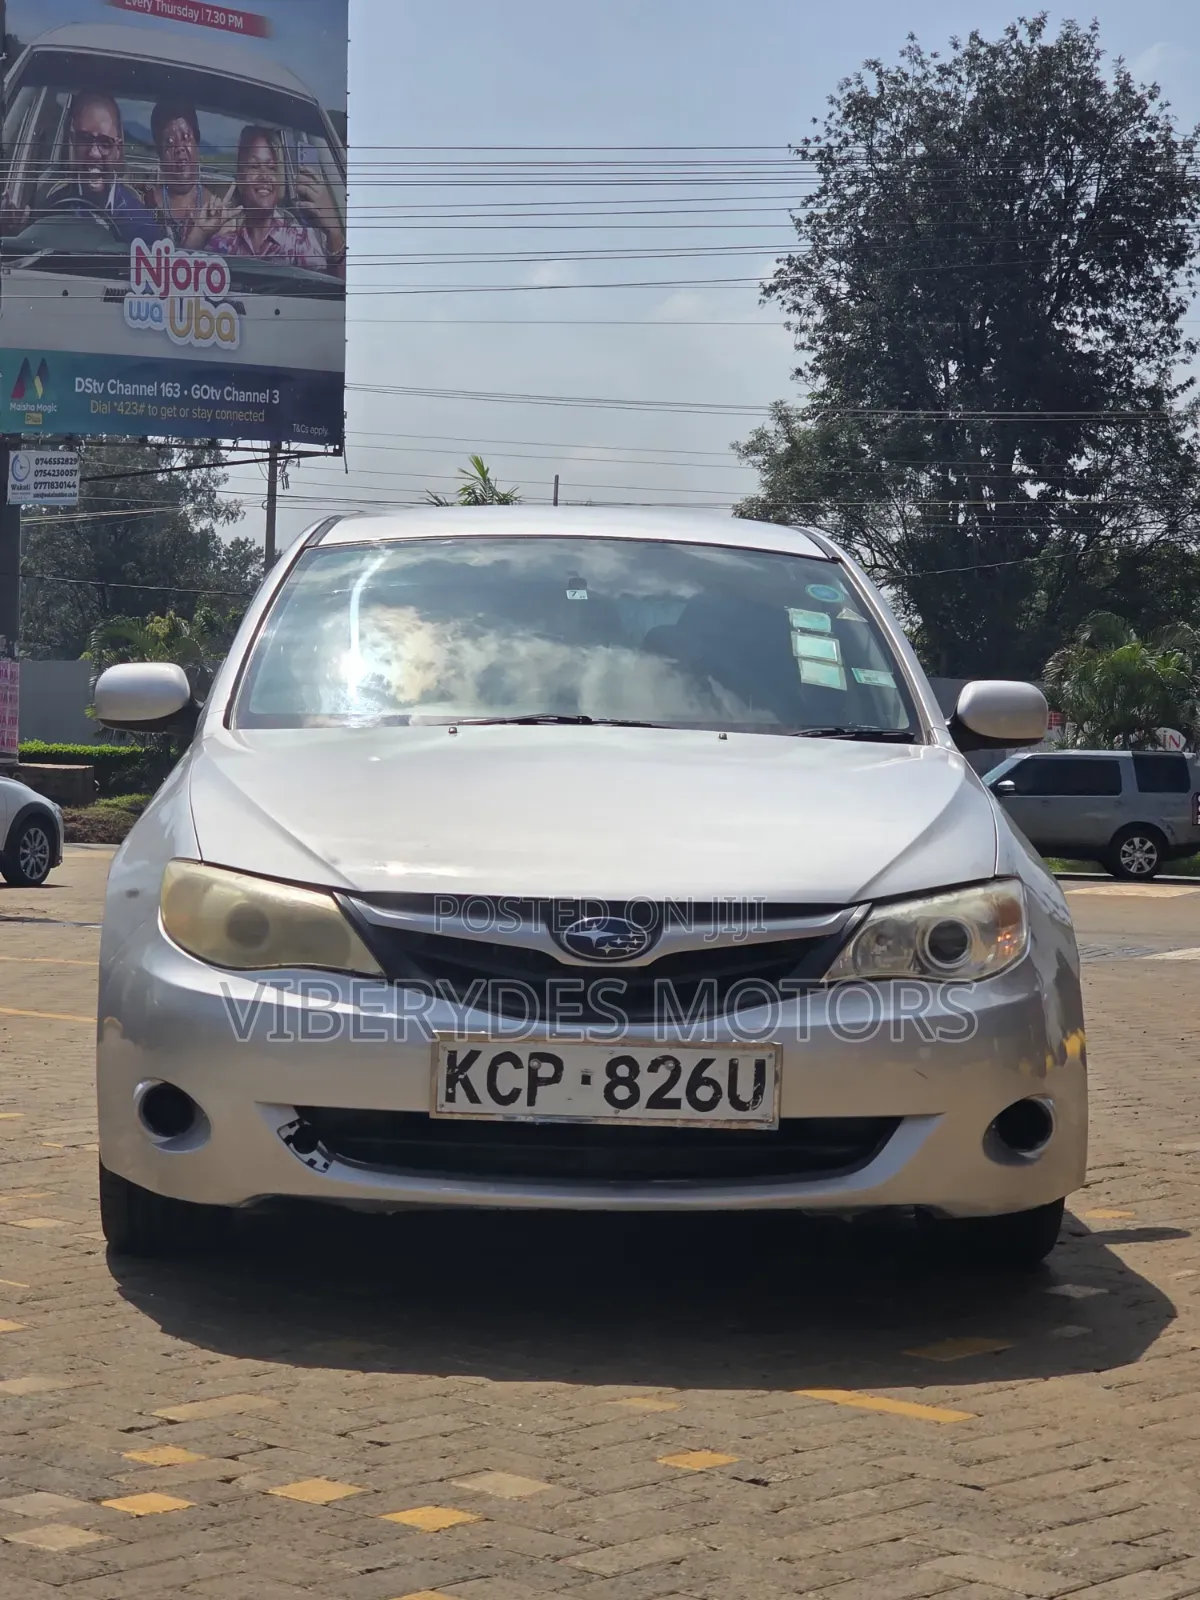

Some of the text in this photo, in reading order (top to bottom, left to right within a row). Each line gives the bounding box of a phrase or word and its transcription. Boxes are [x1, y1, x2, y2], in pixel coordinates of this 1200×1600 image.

[155, 0, 200, 22] Thursday
[205, 9, 226, 25] 7.30
[228, 14, 244, 29] PM
[135, 244, 226, 300] Njoro
[128, 296, 236, 343] wa Uba
[74, 376, 280, 404] DStv Channel 163 GOtv Channel 3
[9, 402, 58, 414] Maisha Magic
[90, 399, 111, 414] Dial
[147, 403, 158, 416] to
[160, 404, 177, 420] get
[179, 406, 189, 418] or
[191, 405, 213, 422] stay
[215, 409, 265, 422] connected
[292, 423, 309, 434] T&Cs
[33, 481, 77, 490] 0771830144
[34, 469, 78, 478] 0754230057
[444, 1049, 766, 1113] KCP 826U
